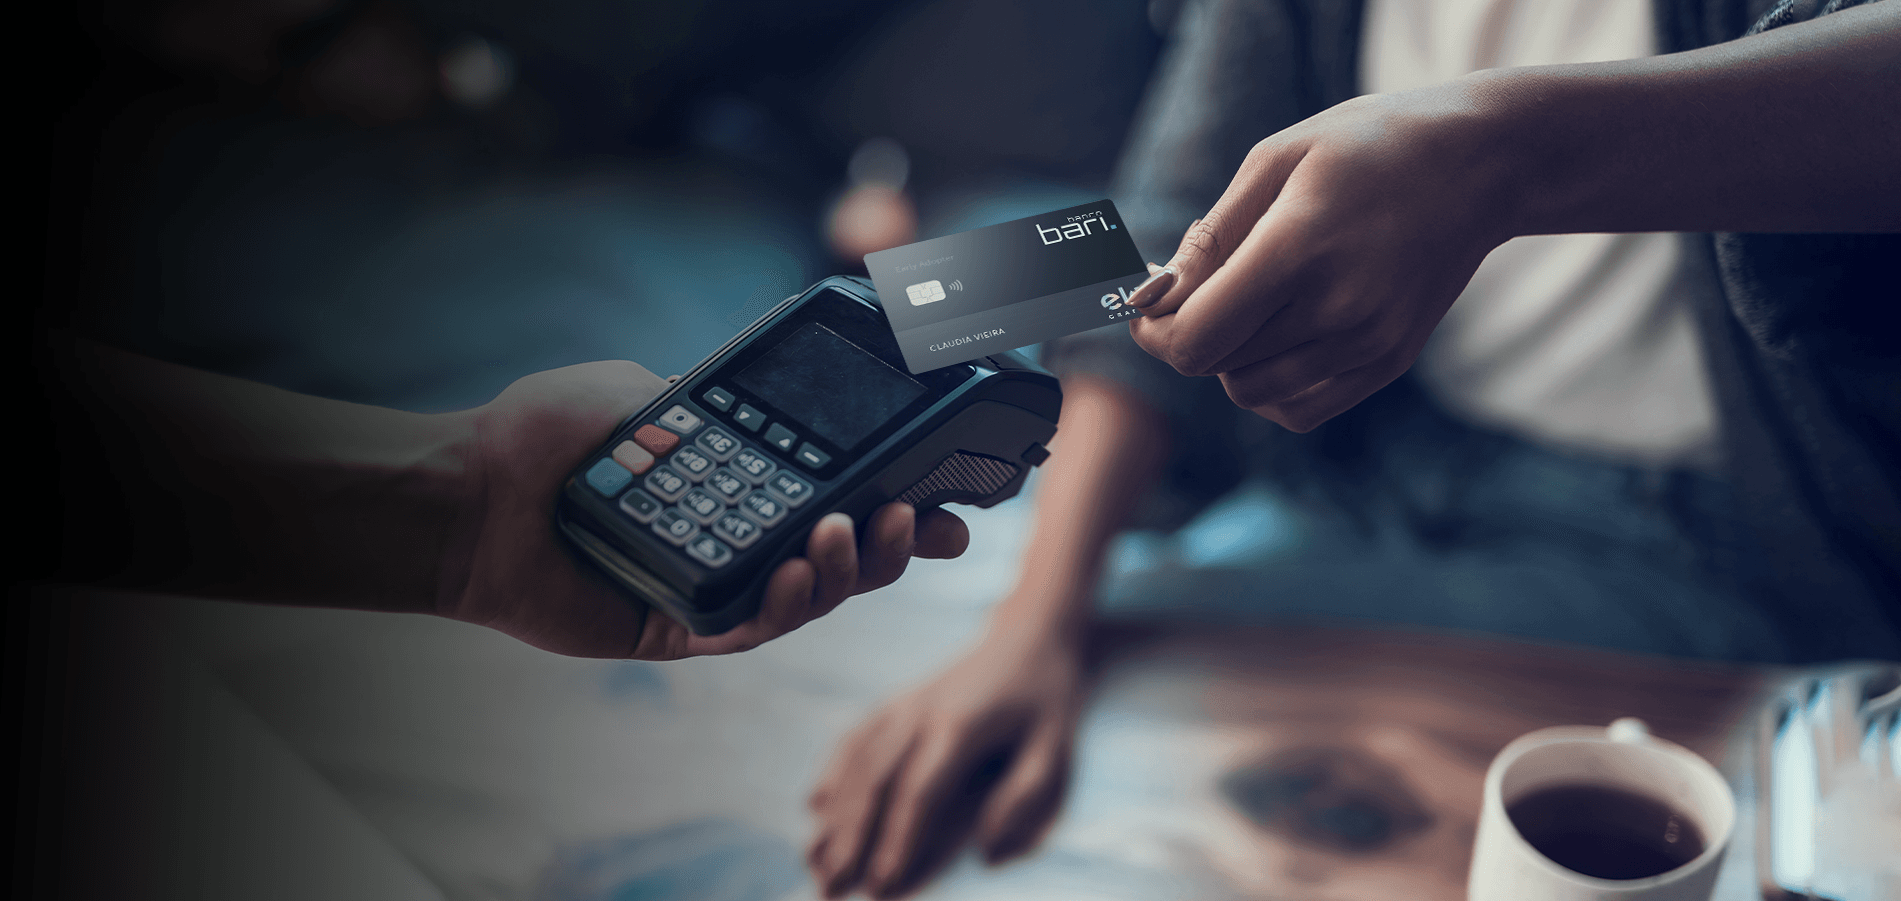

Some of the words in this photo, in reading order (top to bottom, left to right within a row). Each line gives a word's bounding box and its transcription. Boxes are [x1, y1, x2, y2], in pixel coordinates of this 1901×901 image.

[895, 263, 917, 273] Early
[919, 255, 954, 267] Adopter
[929, 336, 973, 352] CLAUDIA
[973, 327, 1006, 341] VIEIRA
